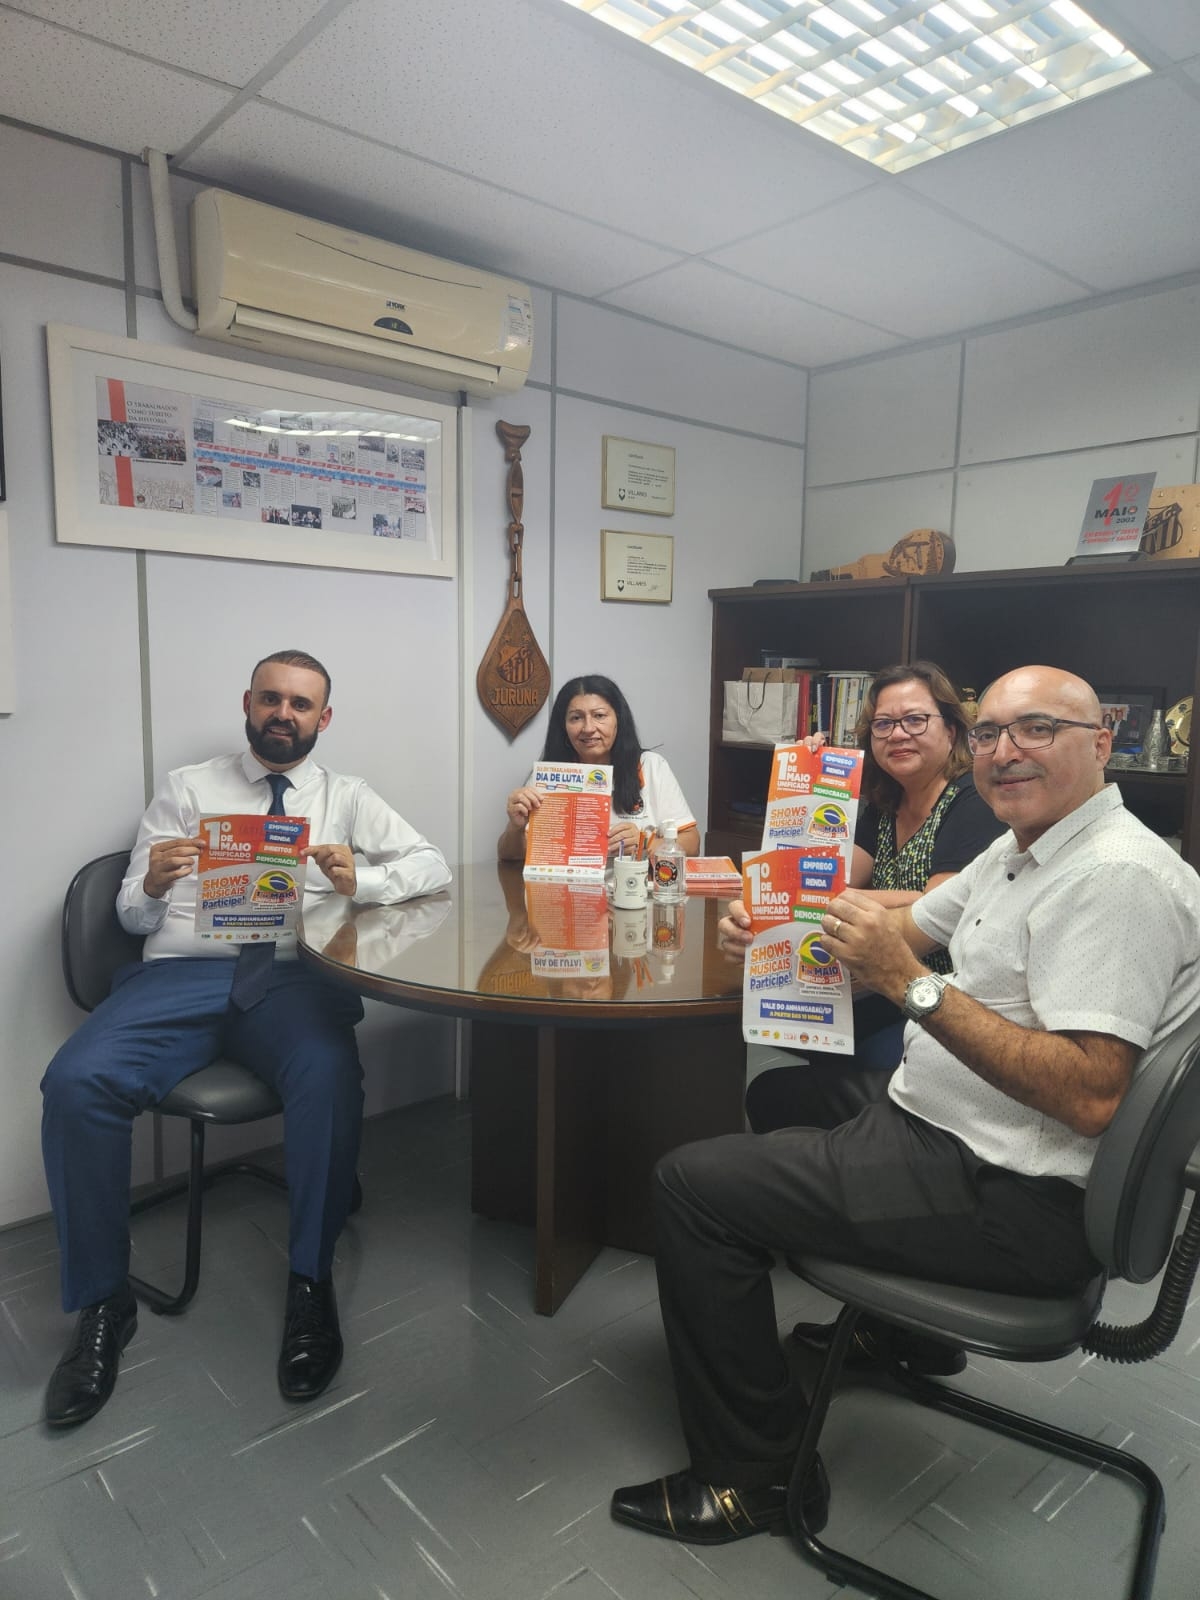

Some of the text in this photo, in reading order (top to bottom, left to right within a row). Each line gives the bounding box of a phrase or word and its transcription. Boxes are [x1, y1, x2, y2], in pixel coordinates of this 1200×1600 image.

[1095, 506, 1138, 519] MAIO
[492, 688, 539, 705] JURUNA
[825, 755, 853, 766] EMPREGO
[826, 767, 845, 776] RENDA
[536, 773, 548, 781] DIA
[550, 773, 560, 782] DE
[562, 774, 584, 783] LUTA!
[786, 773, 811, 783] MAIO
[777, 781, 810, 790] UNIFICADO
[813, 786, 850, 799] DEMOCRACIA
[771, 806, 808, 819] SHOWS
[268, 824, 299, 832] EMPREGO
[769, 818, 804, 827] MUSICAIS
[769, 827, 804, 838] Participe!
[269, 835, 291, 843] RENDA
[221, 842, 252, 851] MAIO
[209, 850, 251, 858] UNIFICADO
[256, 856, 297, 866] DEMOCRACIA
[803, 860, 833, 871] EMPREGO
[202, 875, 250, 890] SHOWS
[761, 882, 772, 891] DE
[805, 878, 827, 888] RENDA
[202, 888, 246, 899] MUSICAIS
[761, 892, 790, 905] MAIO
[202, 896, 246, 910] Participe!
[801, 894, 830, 905] DIREITOS
[752, 905, 790, 915] UNIFICADO
[794, 909, 825, 921] DEMOCRA
[751, 941, 791, 963] SHOWS
[749, 957, 791, 976] MUSICAIS
[815, 966, 839, 976] MAIO
[750, 972, 791, 990] Participe!
[762, 1002, 775, 1010] VALE
